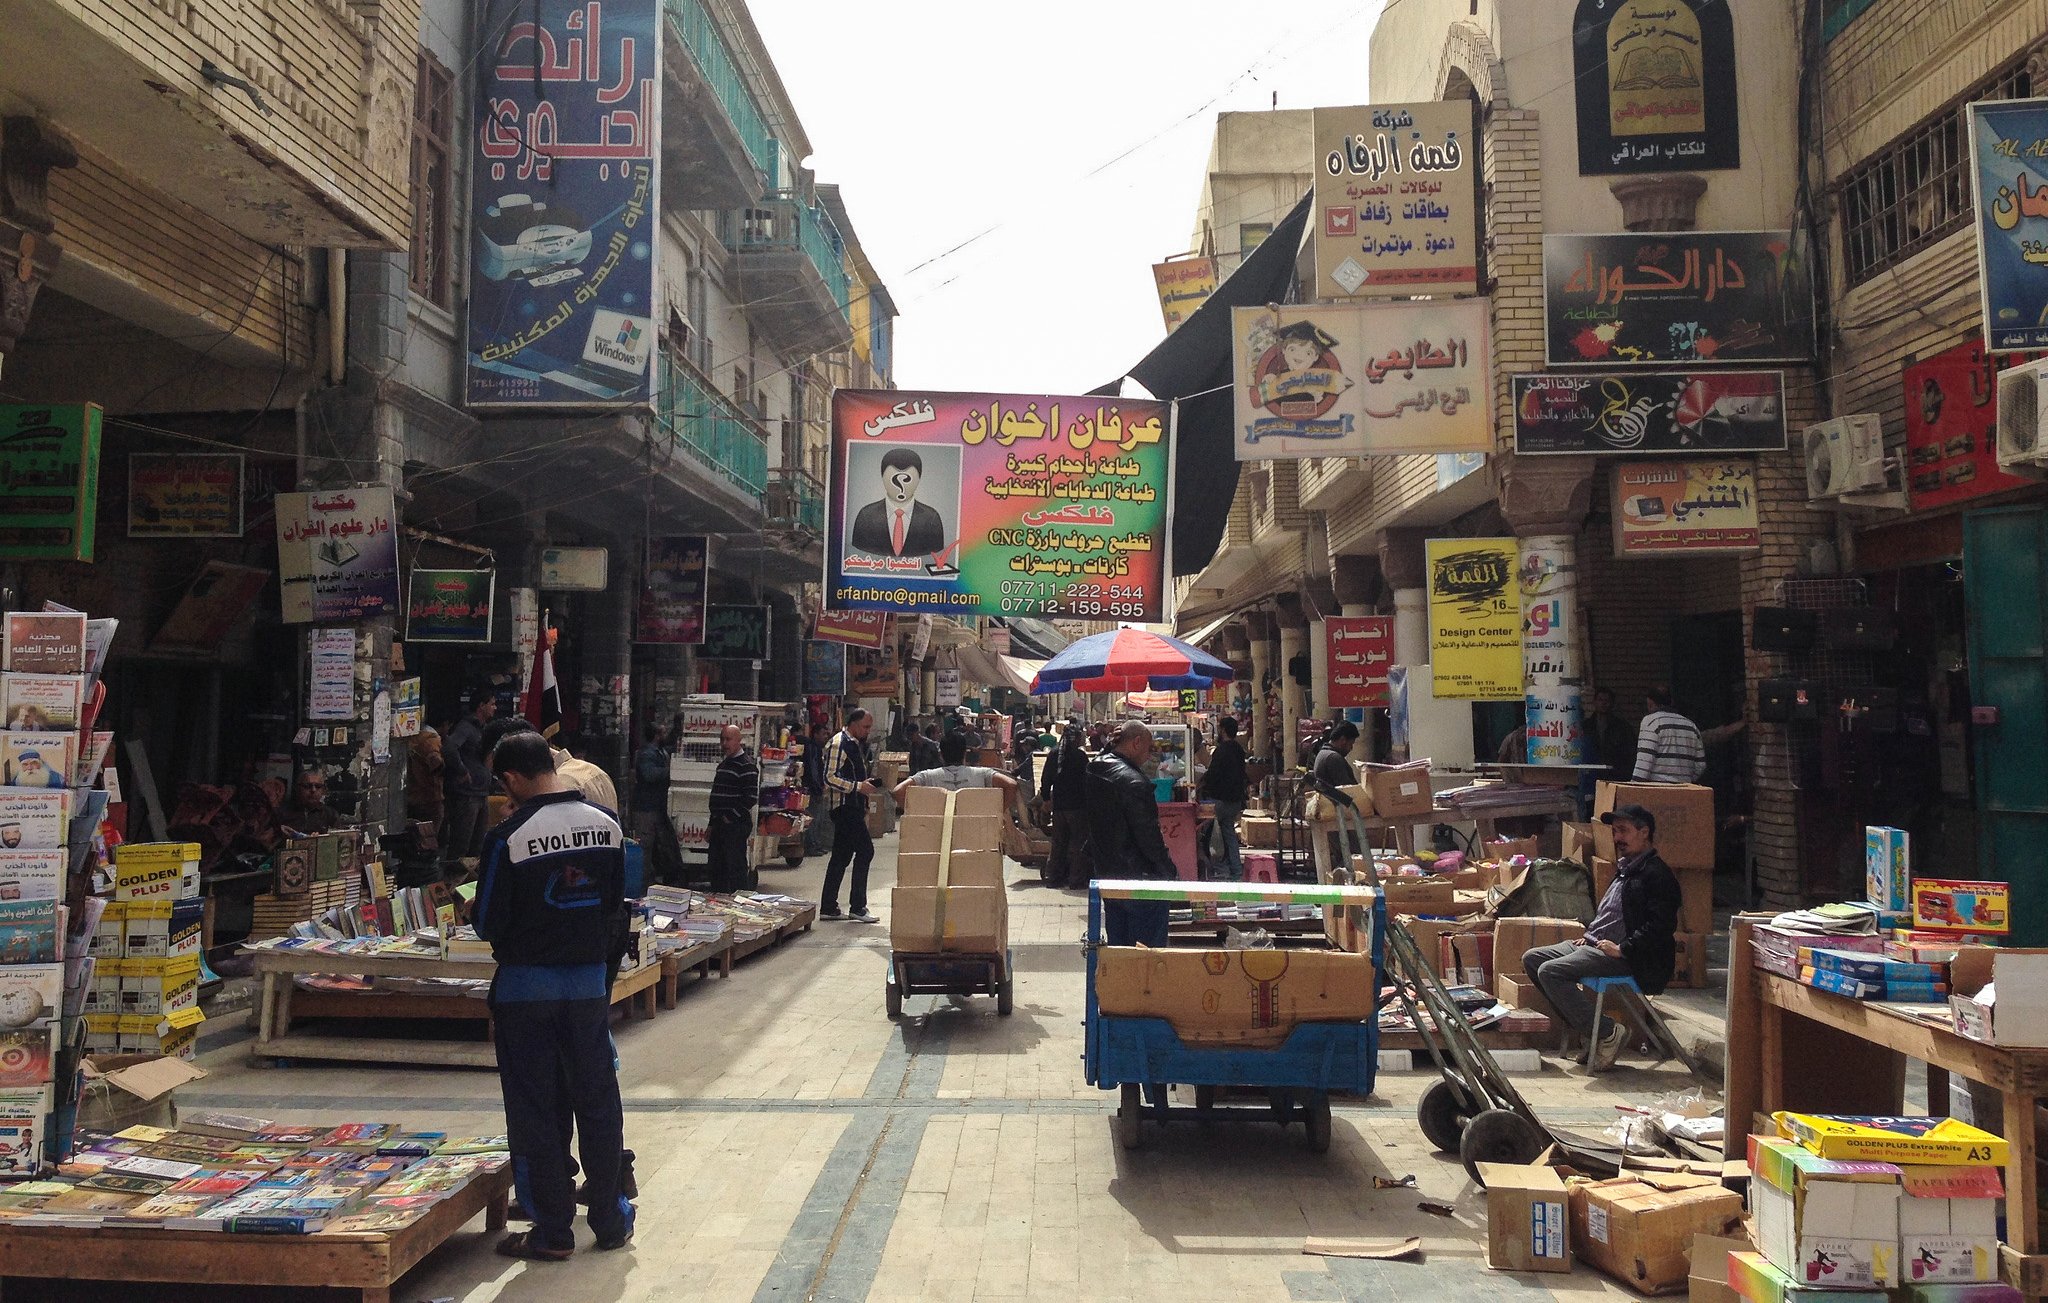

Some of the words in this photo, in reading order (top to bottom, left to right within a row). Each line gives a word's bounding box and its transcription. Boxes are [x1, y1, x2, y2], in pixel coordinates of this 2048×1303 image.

[495, 2, 636, 103] رائد
[480, 78, 654, 181] الجبوري
[1372, 110, 1414, 131] شركة
[1326, 133, 1403, 182] الرفاه
[1410, 132, 1463, 173] قمة
[1611, 142, 1659, 165] العراقي
[1665, 141, 1706, 159] للكتاب
[1992, 138, 2019, 157] AL
[1346, 182, 1393, 200] الحصرية
[1400, 181, 1442, 195] للوكالات
[1360, 201, 1392, 225] زفاف
[1402, 198, 1449, 223] بطاقات
[1425, 233, 1455, 255] دعوة
[1563, 248, 1700, 305] الحوراء
[1704, 248, 1746, 303] دار
[594, 340, 636, 366] Windows
[864, 399, 936, 437] فلكس
[960, 401, 1060, 446] اخوان
[1067, 404, 1163, 451] عرفان
[1006, 453, 1047, 475] كبيرة
[1049, 452, 1098, 478] بأحجام
[1099, 456, 1141, 476] طباعة
[984, 476, 1051, 499] الانتخابية
[1052, 480, 1112, 504] الدعايات
[1114, 484, 1156, 506] طباعة
[312, 494, 356, 516] مكتبة
[1672, 484, 1750, 522] المتنبي
[366, 516, 389, 537] دار
[1022, 504, 1116, 527] فلكس
[329, 518, 364, 540] علوم
[988, 529, 1024, 546] CNC
[1027, 528, 1063, 549] بارزة
[1682, 532, 1724, 545] المالكي
[1726, 532, 1756, 542] احمد
[1065, 528, 1106, 553] حروف
[1108, 533, 1152, 555] تقطيع
[844, 557, 884, 572] مرشحكم
[886, 557, 922, 571] انتخبوا
[1009, 553, 1073, 575] بوسترات
[1083, 555, 1130, 577] كارتات
[1447, 562, 1499, 584] القمة
[836, 586, 981, 606] erfanbro@gmail.com
[1000, 580, 1144, 600] 07711-222-544
[1000, 597, 1144, 617] 07712-159-595
[1492, 599, 1507, 610] 16
[1440, 628, 1476, 639] Design
[1478, 627, 1513, 637] Center
[1335, 646, 1387, 665] فورية
[527, 831, 611, 856] EVOLUTION
[119, 868, 178, 887] GOLDEN
[131, 882, 171, 898] PLUS
[171, 921, 200, 944] GOLDEN
[176, 934, 197, 953] PLUS
[165, 977, 196, 1001] GOLDEN
[171, 991, 192, 1010] PLUS
[1859, 1148, 1883, 1156] Multi
[1884, 1149, 1921, 1158] Purpose
[1922, 1151, 1948, 1159] Paper
[1885, 1141, 1909, 1149] PLUS
[1910, 1143, 1934, 1151] Extra
[1966, 1147, 1992, 1162] A3
